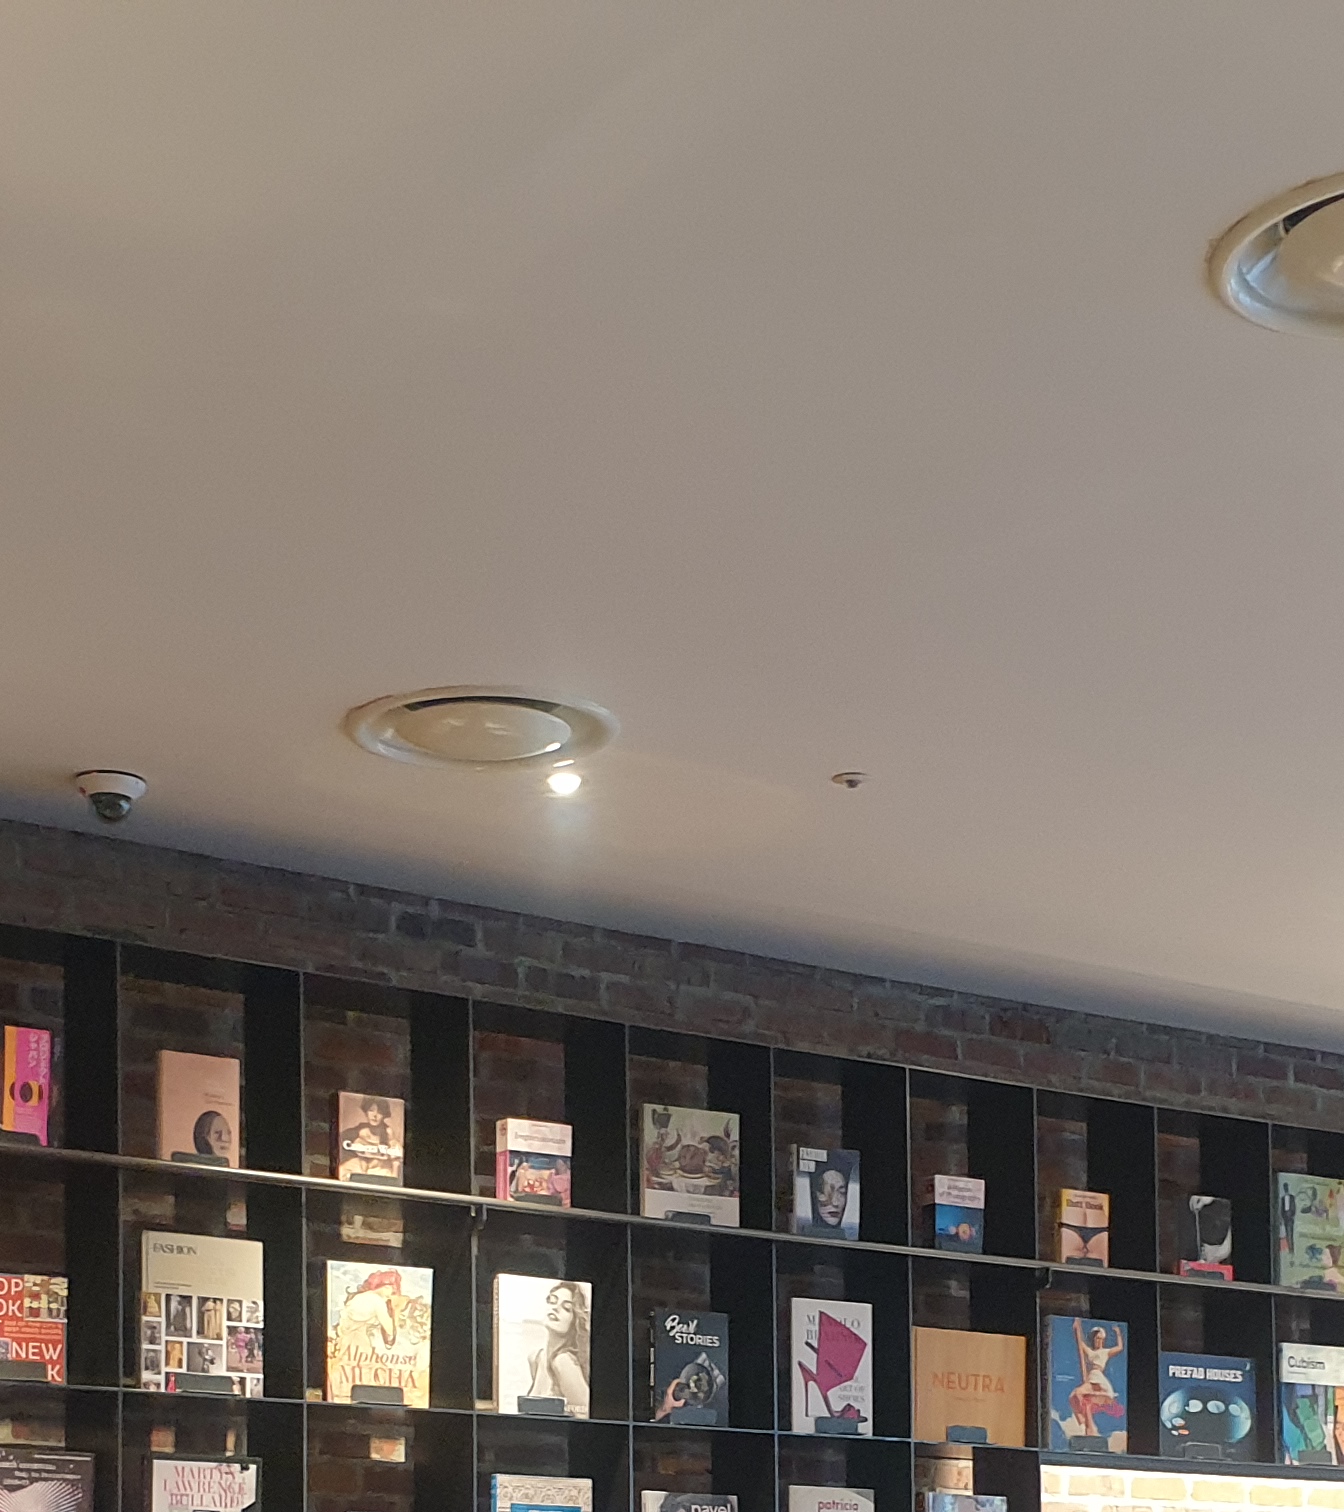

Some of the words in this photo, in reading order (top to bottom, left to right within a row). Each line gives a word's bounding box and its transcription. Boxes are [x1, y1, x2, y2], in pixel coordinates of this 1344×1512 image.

[675, 1333, 721, 1348] STORIES
[11, 1341, 63, 1362] NEW
[339, 1344, 418, 1366] Alphonse
[1287, 1355, 1326, 1371] Cubism
[339, 1365, 419, 1390] MUCHA
[932, 1371, 1006, 1394] NEUTRA
[1169, 1365, 1205, 1380] PREFAB
[1206, 1368, 1244, 1383] HOUSES
